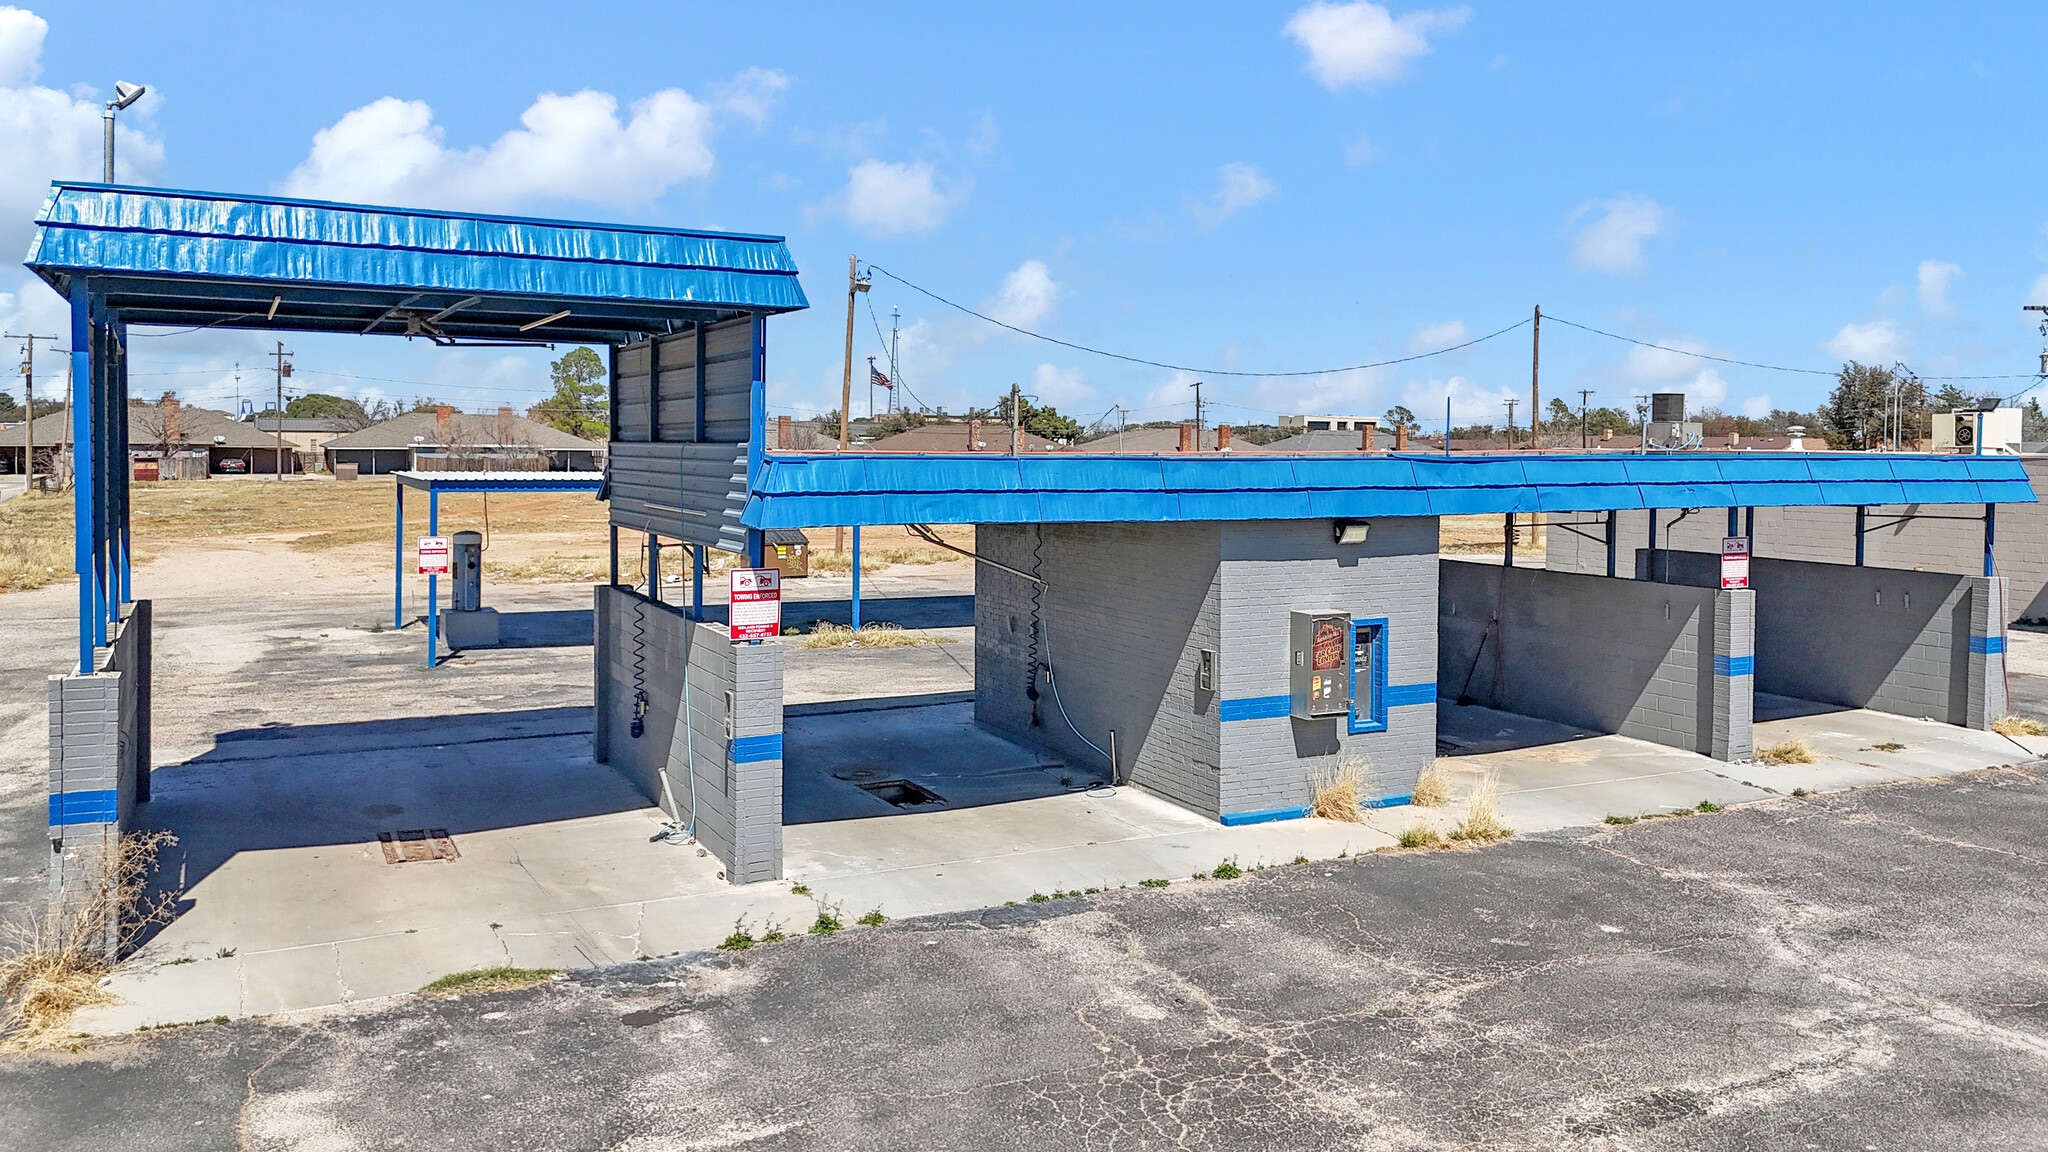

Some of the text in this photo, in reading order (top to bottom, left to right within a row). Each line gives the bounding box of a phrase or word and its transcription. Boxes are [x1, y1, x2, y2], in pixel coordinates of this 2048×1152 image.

[1315, 651, 1325, 660] CAR
[1326, 645, 1341, 655] CARE
[1317, 652, 1339, 665] CENTER
